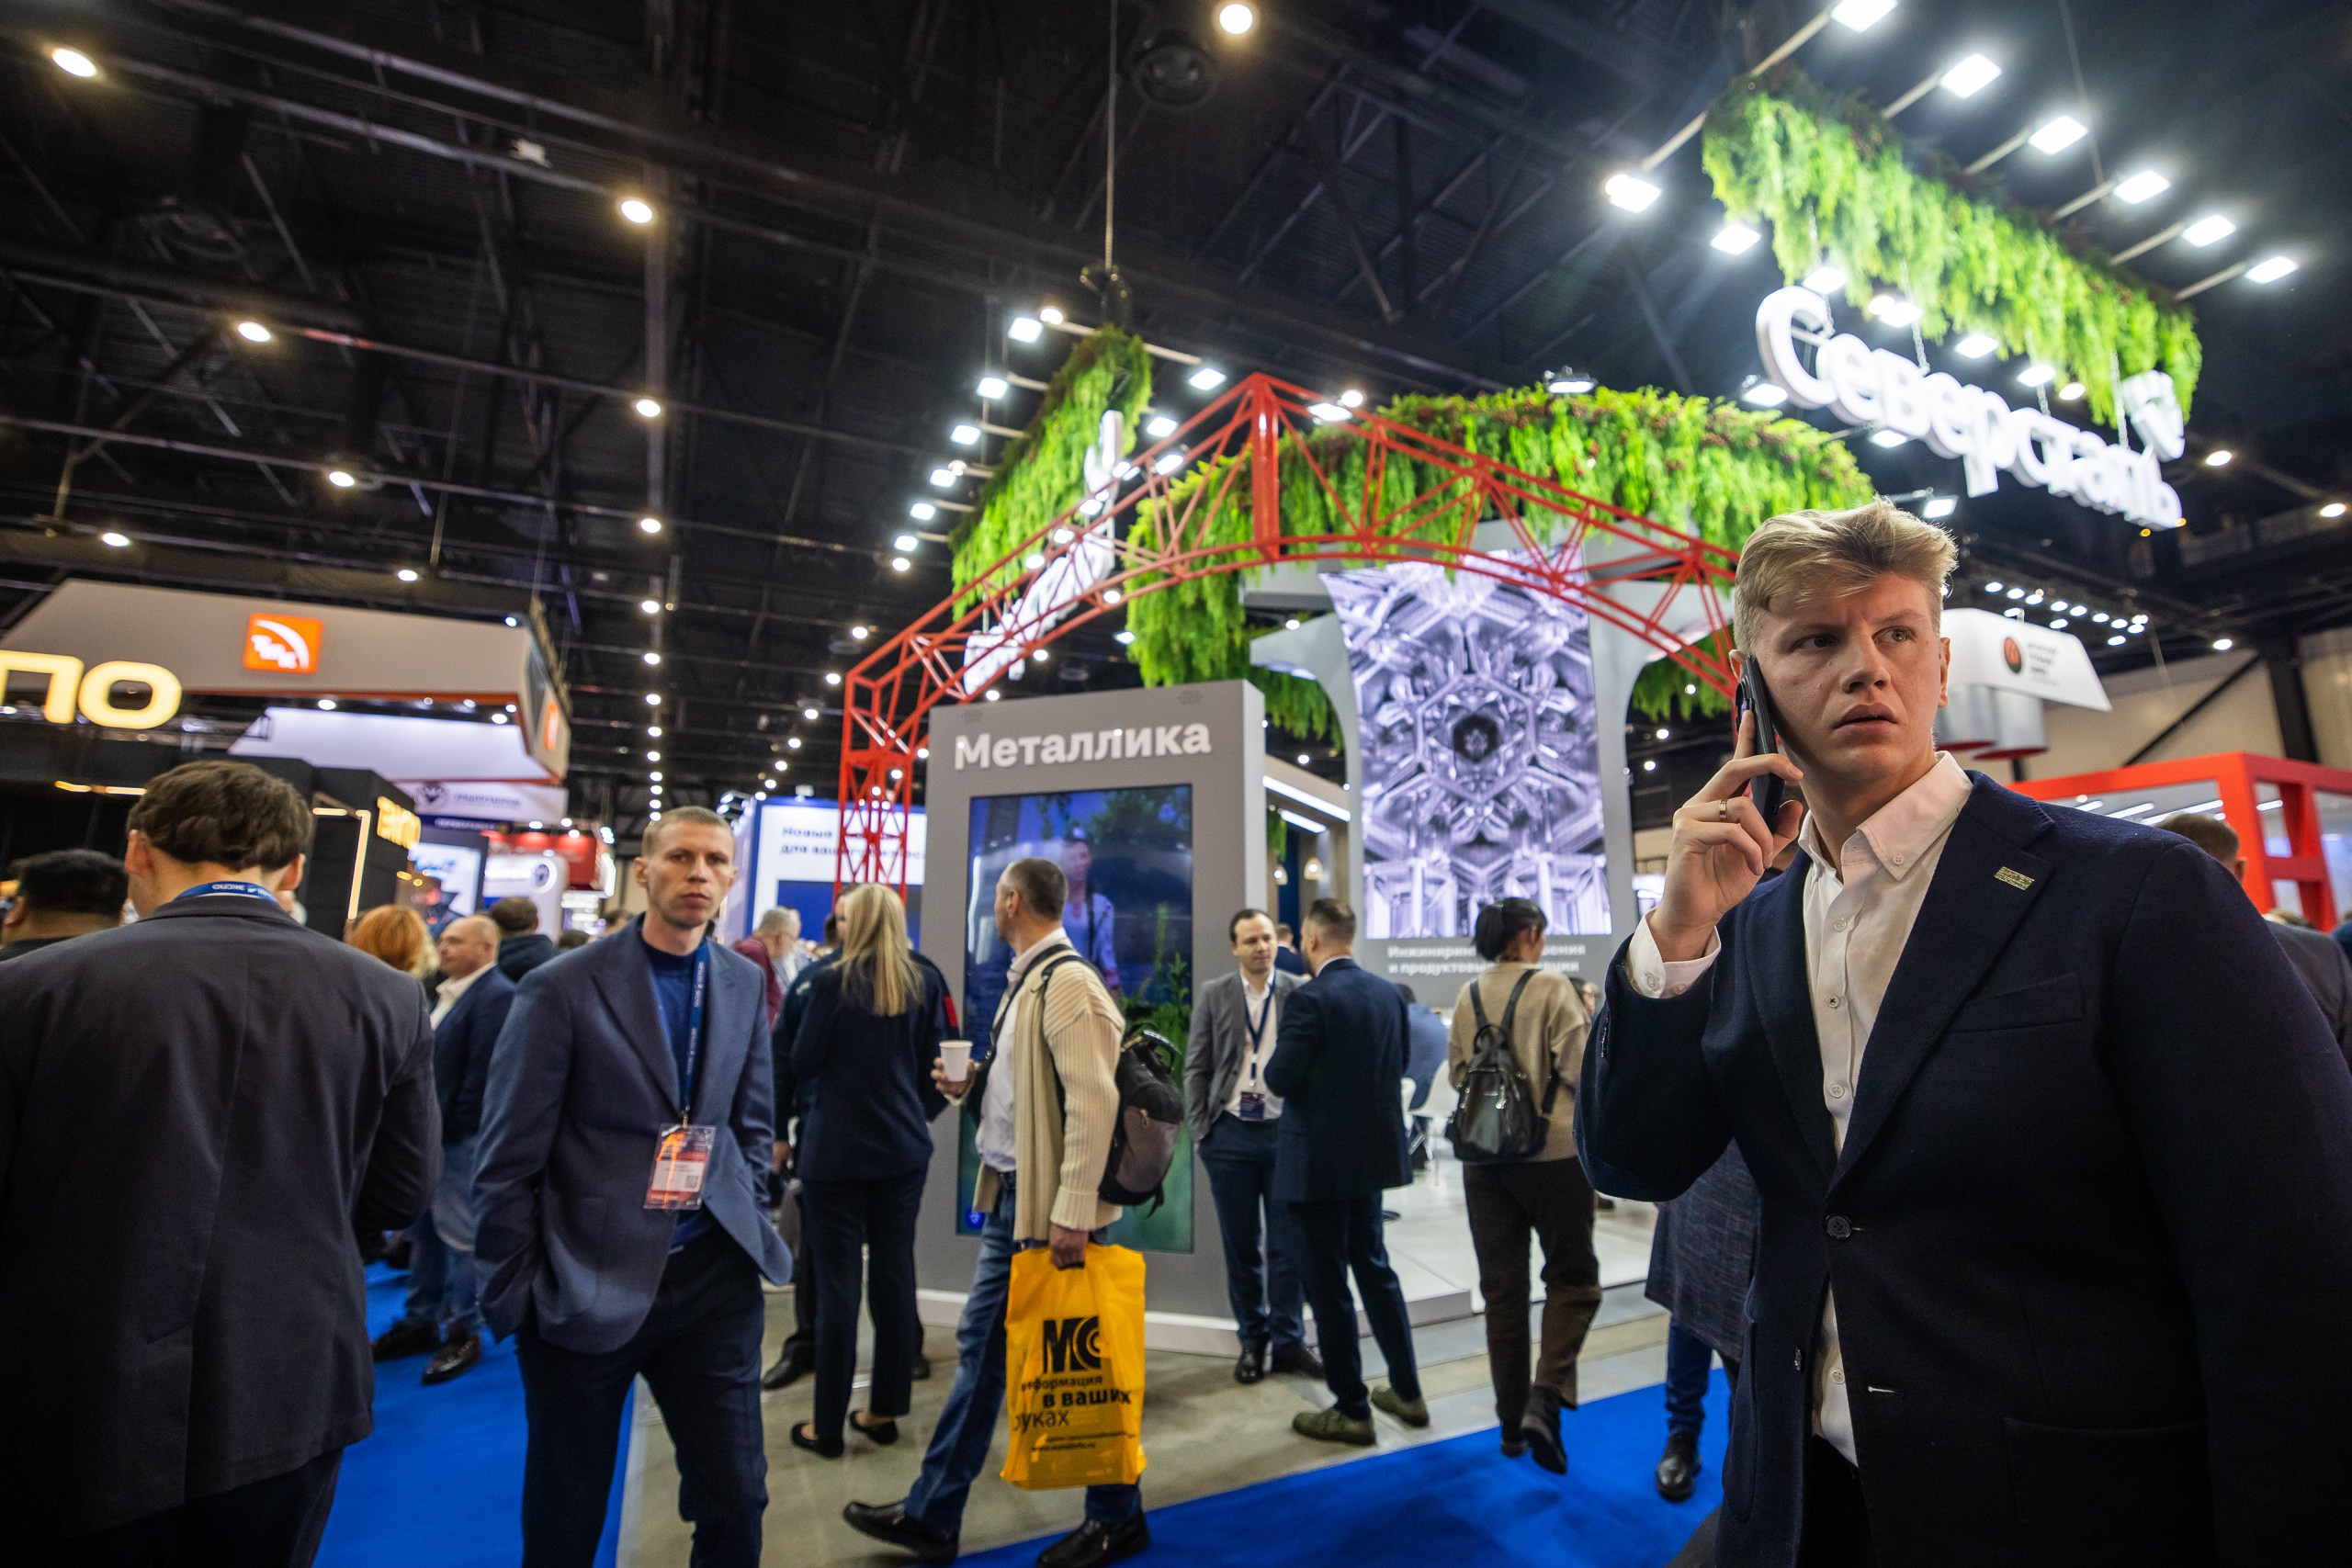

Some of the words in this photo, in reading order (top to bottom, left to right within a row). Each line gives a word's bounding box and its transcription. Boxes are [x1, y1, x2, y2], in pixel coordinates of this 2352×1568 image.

[1756, 286, 2183, 531] Северсталь
[954, 722, 1213, 771] Металлика
[1042, 1393, 1056, 1408] в
[1061, 1388, 1132, 1406] ваших
